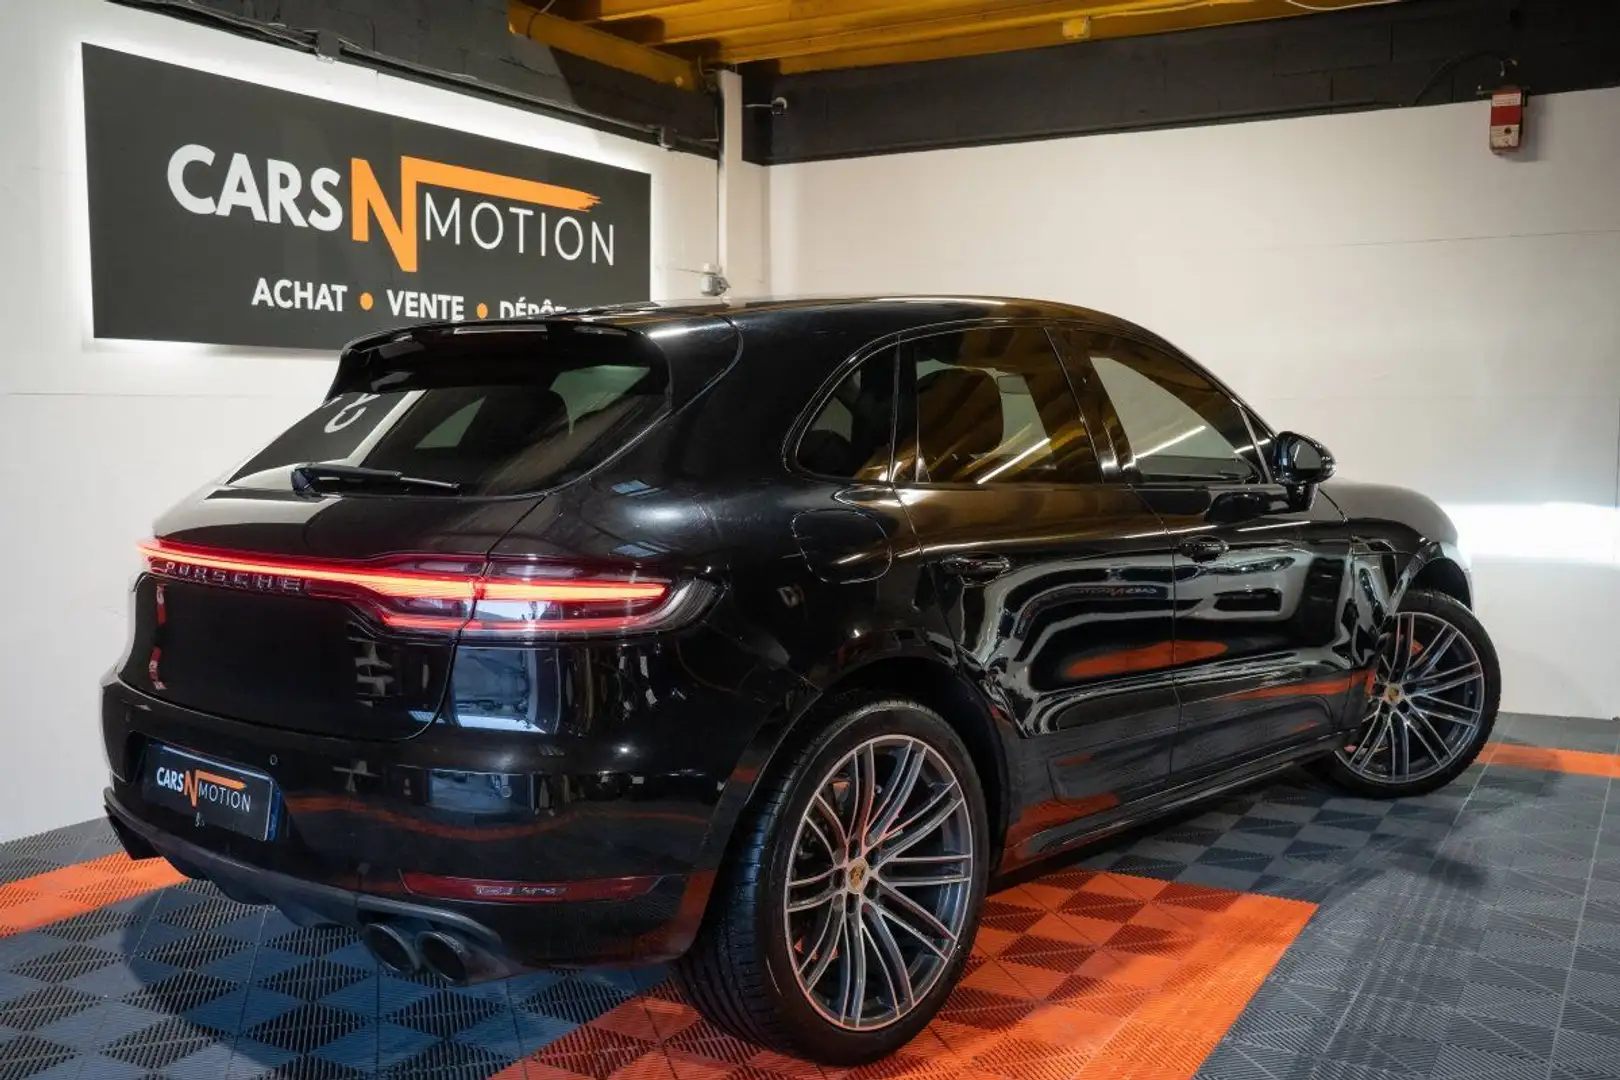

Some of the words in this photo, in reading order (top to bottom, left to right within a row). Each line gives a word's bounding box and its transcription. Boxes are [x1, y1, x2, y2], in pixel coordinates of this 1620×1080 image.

[251, 277, 348, 312] ACHAT
[386, 289, 465, 322] VENTE
[499, 296, 567, 319] DÉPÔ
